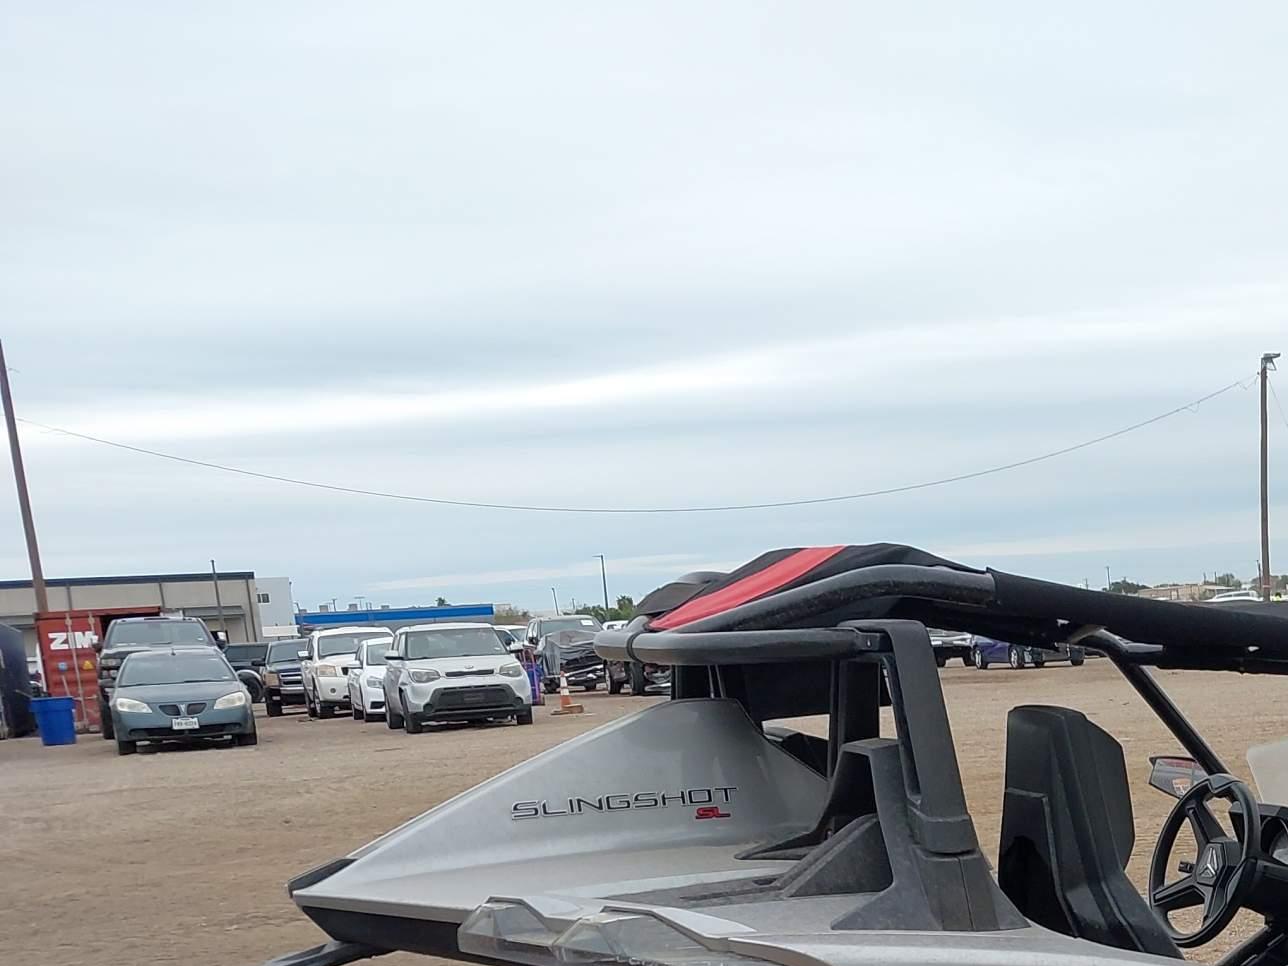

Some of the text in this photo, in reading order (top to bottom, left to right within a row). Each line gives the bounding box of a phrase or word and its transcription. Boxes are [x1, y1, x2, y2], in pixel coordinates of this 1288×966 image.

[47, 631, 96, 650] ZIM
[511, 786, 737, 821] SLINGSHOT
[695, 806, 731, 820] SL
